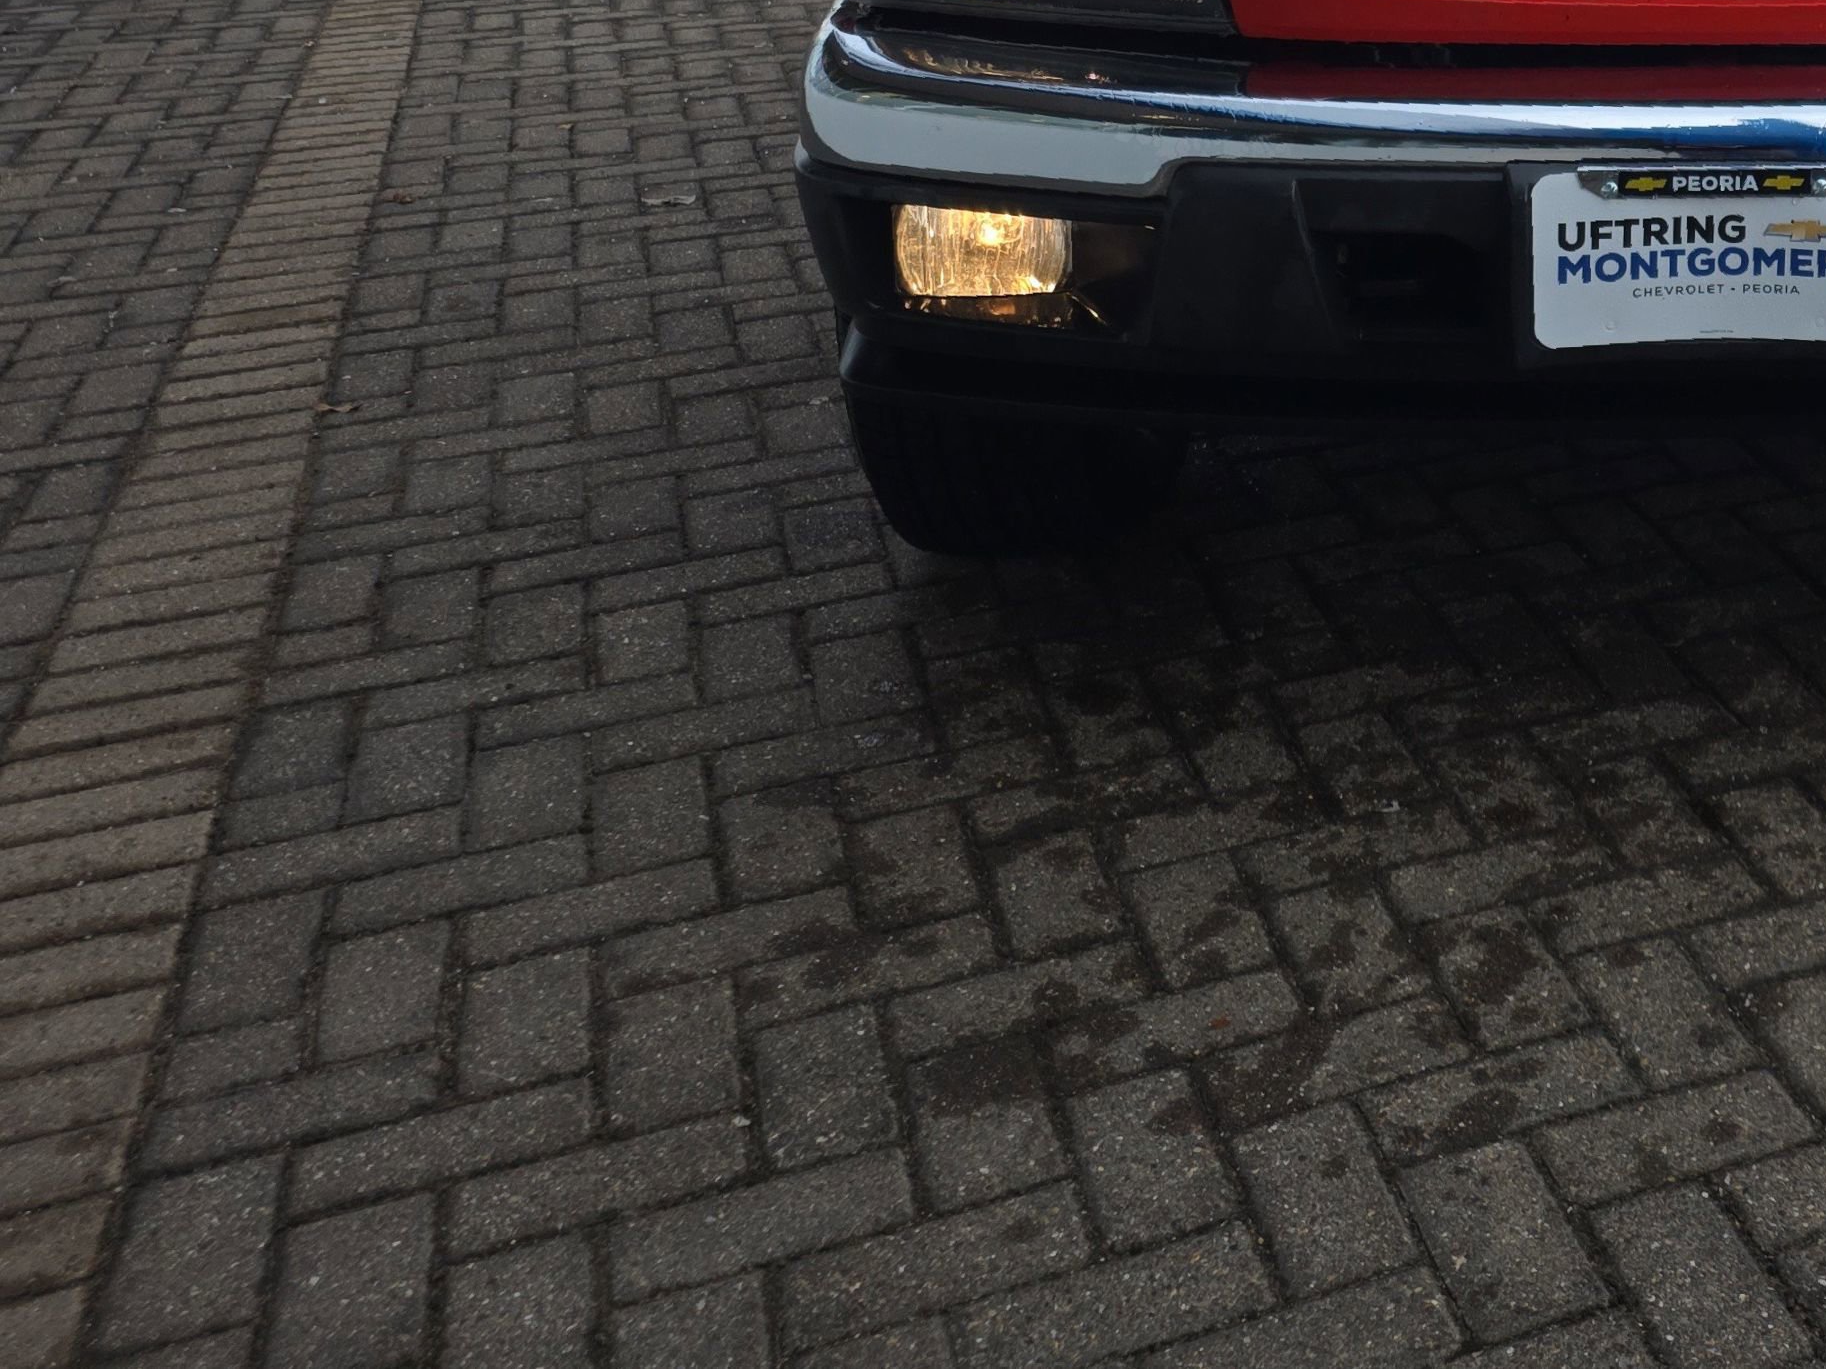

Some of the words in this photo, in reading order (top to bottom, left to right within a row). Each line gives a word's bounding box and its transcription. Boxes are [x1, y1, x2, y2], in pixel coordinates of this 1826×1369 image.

[1672, 174, 1759, 193] PEORIA
[1557, 214, 1747, 252] UFTRING
[1632, 283, 1725, 298] CHEVROLET
[1742, 283, 1800, 295] PEORIA
